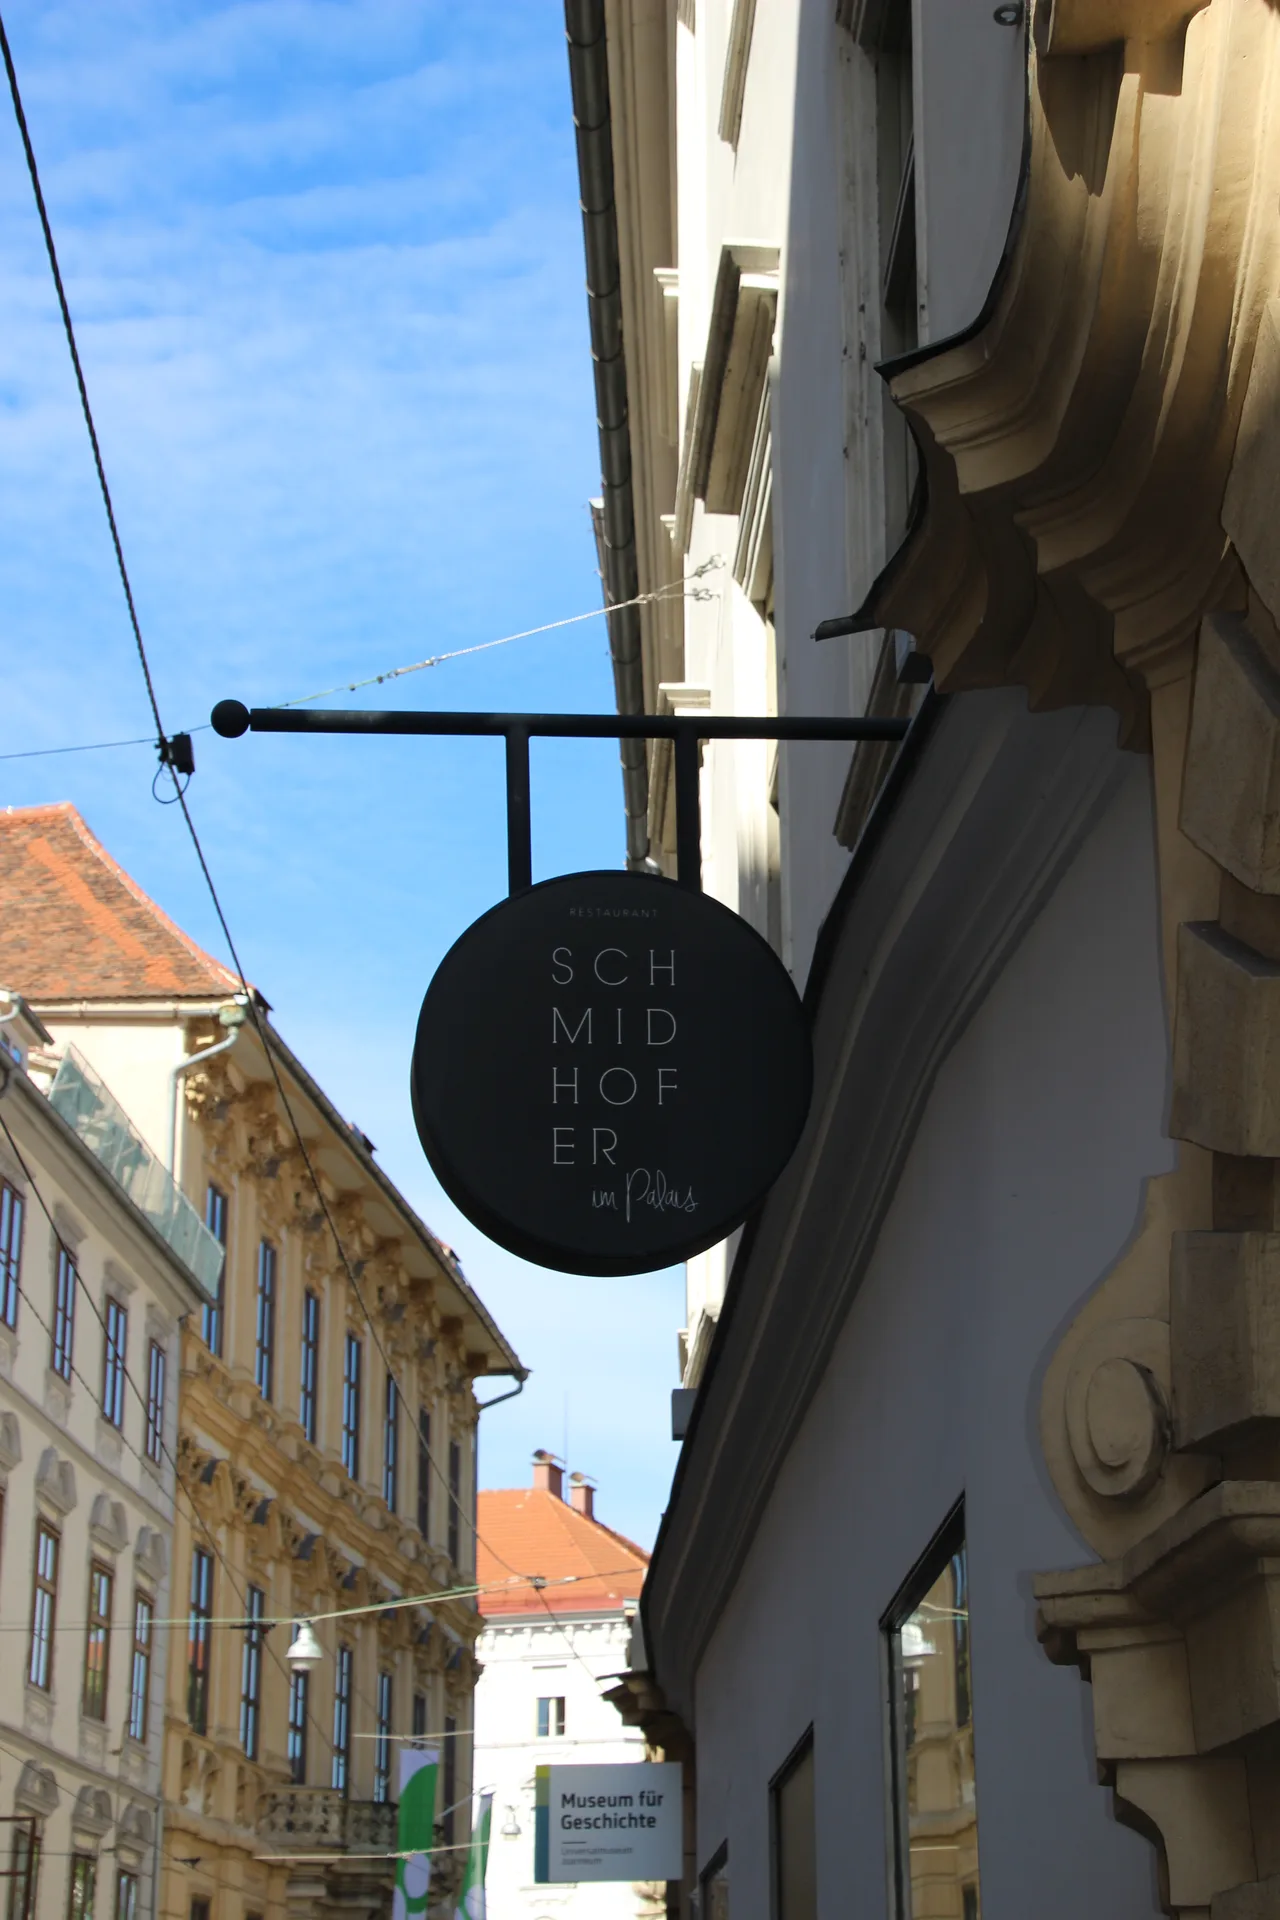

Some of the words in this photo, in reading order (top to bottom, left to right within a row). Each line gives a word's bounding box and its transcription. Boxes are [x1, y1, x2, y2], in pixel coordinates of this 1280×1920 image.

[569, 907, 658, 918] RESTAURANT
[592, 1189, 619, 1210] im
[625, 1167, 699, 1223] Palais
[561, 1793, 633, 1808] Museum
[638, 1790, 664, 1807] für
[561, 1813, 656, 1830] Geschichte
